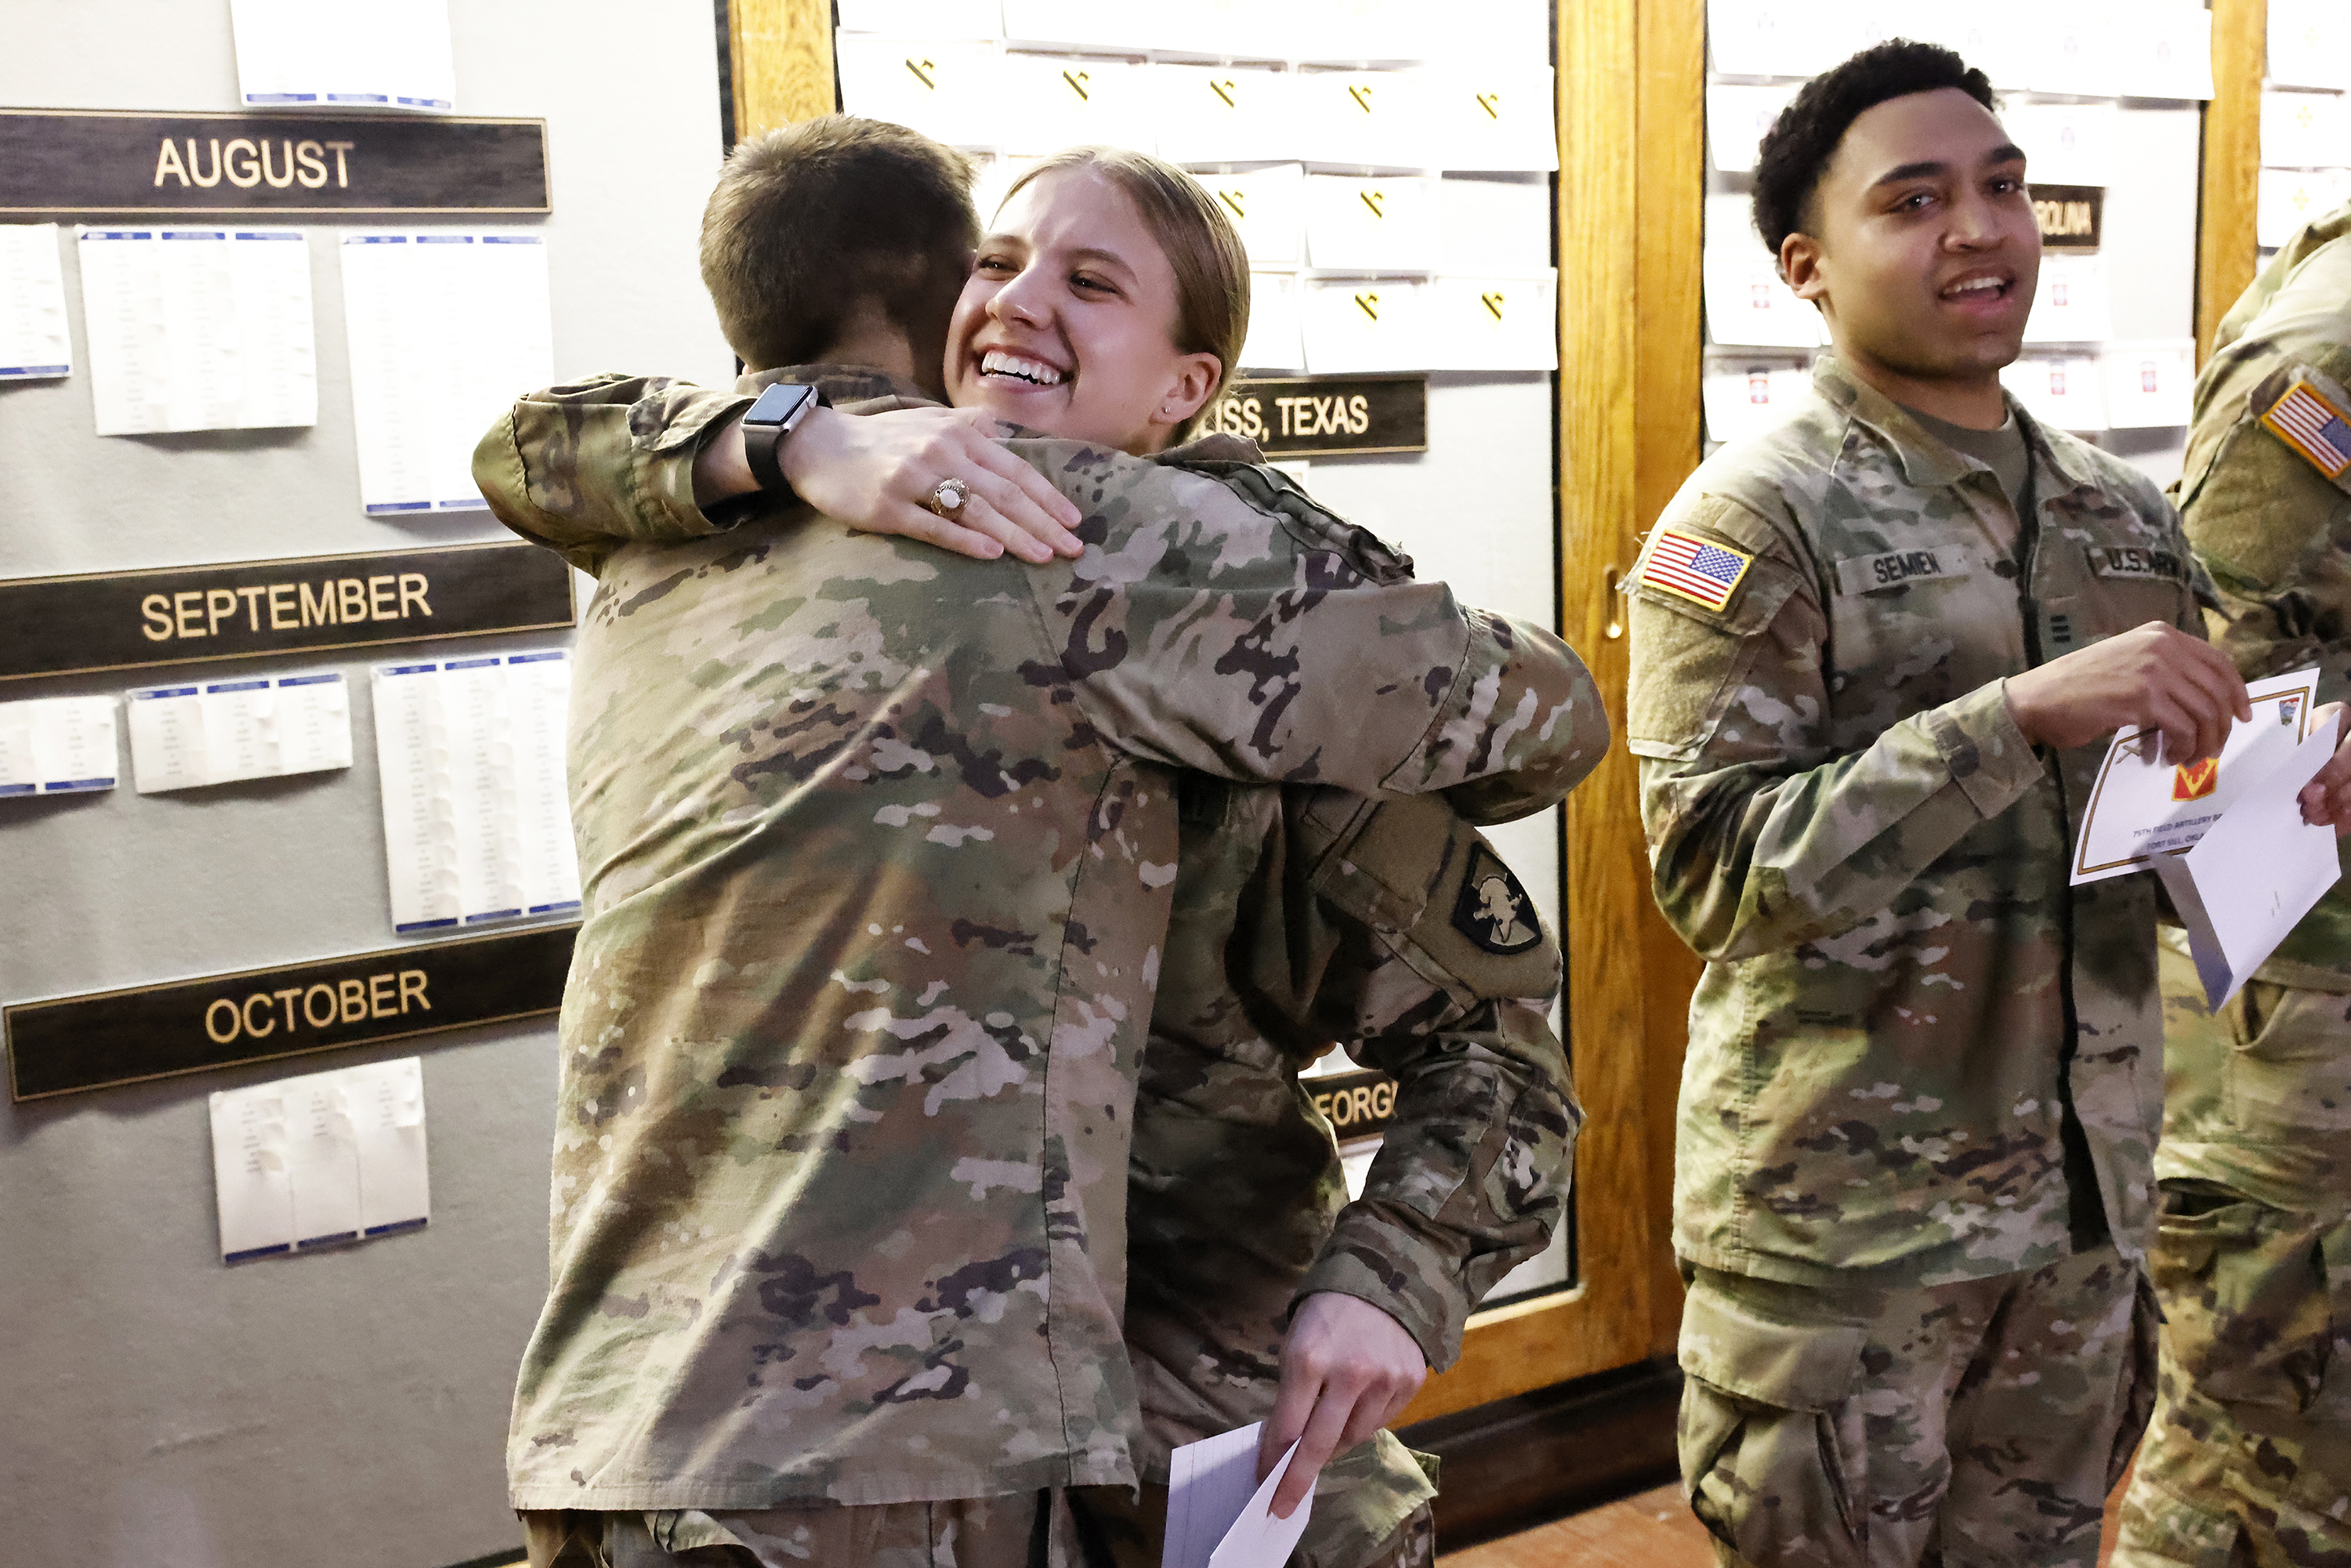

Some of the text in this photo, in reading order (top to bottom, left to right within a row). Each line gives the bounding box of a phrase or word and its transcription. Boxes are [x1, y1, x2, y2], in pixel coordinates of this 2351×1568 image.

[154, 138, 354, 188] AUGUST
[1196, 395, 1369, 443] LISS, TEXAS
[1873, 551, 1942, 583] SEMIEN
[141, 573, 433, 641] SEPTEMBER
[2133, 828, 2152, 838] 75TH
[2153, 824, 2172, 834] FIELD
[2174, 816, 2212, 830] ARTILLERY
[205, 969, 431, 1044] OCTOBER
